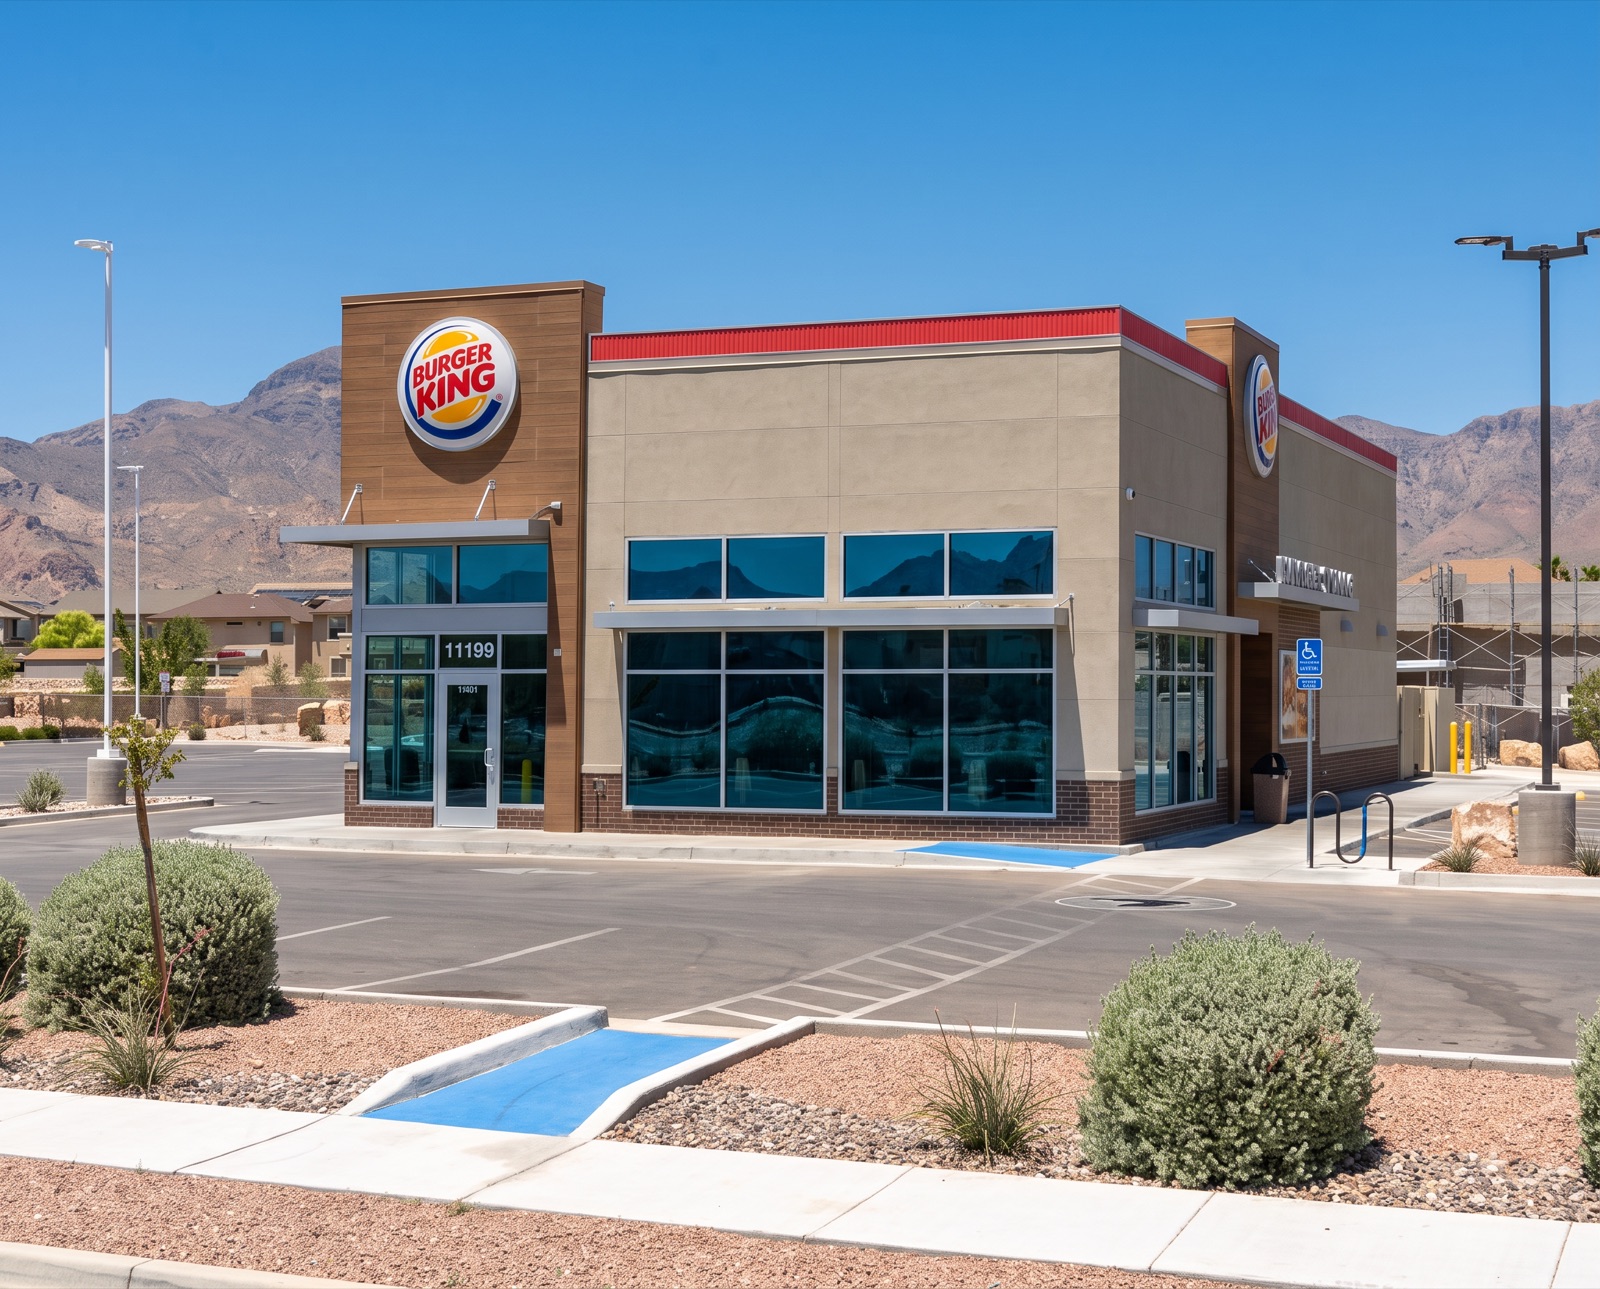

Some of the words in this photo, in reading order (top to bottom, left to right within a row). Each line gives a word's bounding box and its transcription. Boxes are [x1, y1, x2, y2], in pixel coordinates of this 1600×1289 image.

[413, 343, 492, 389] BURGER
[417, 362, 496, 418] KING
[445, 642, 495, 659] 11199
